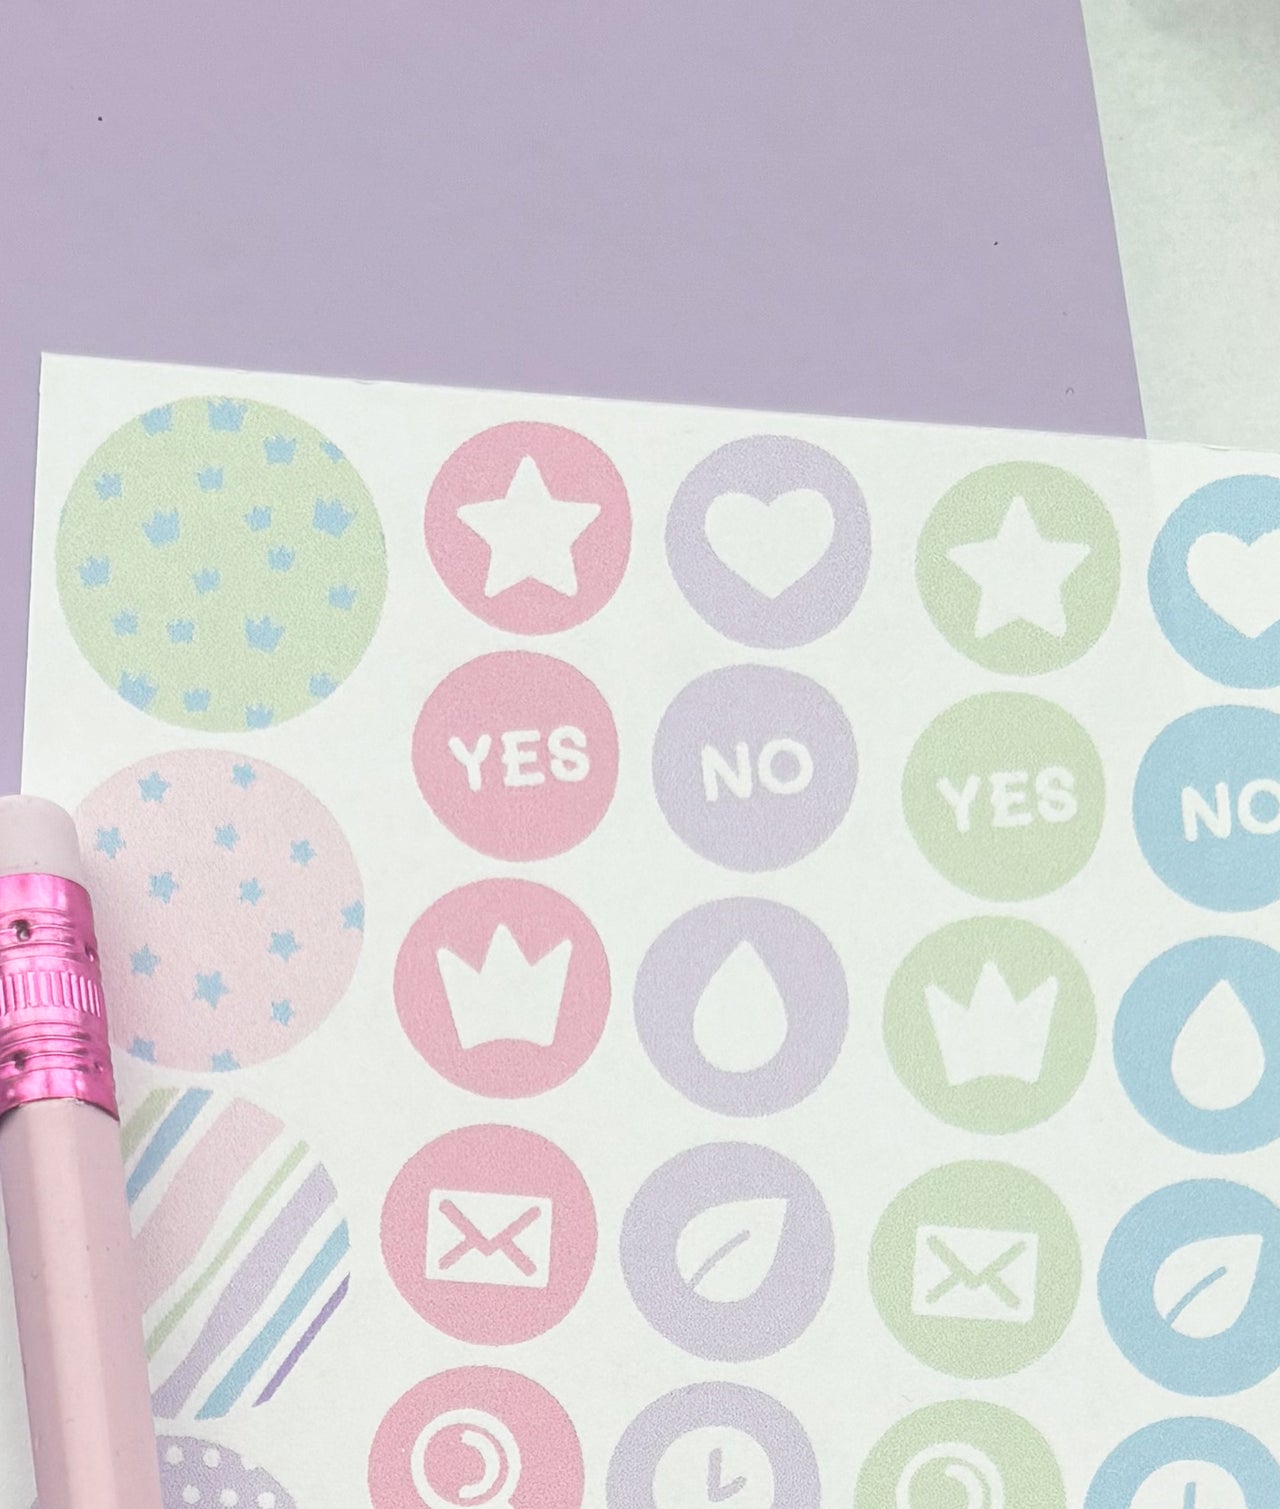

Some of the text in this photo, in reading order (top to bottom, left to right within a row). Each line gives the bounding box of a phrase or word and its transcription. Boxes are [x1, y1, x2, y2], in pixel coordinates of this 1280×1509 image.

[447, 724, 590, 792] YES
[698, 736, 817, 802] NO
[936, 763, 1079, 833] YES
